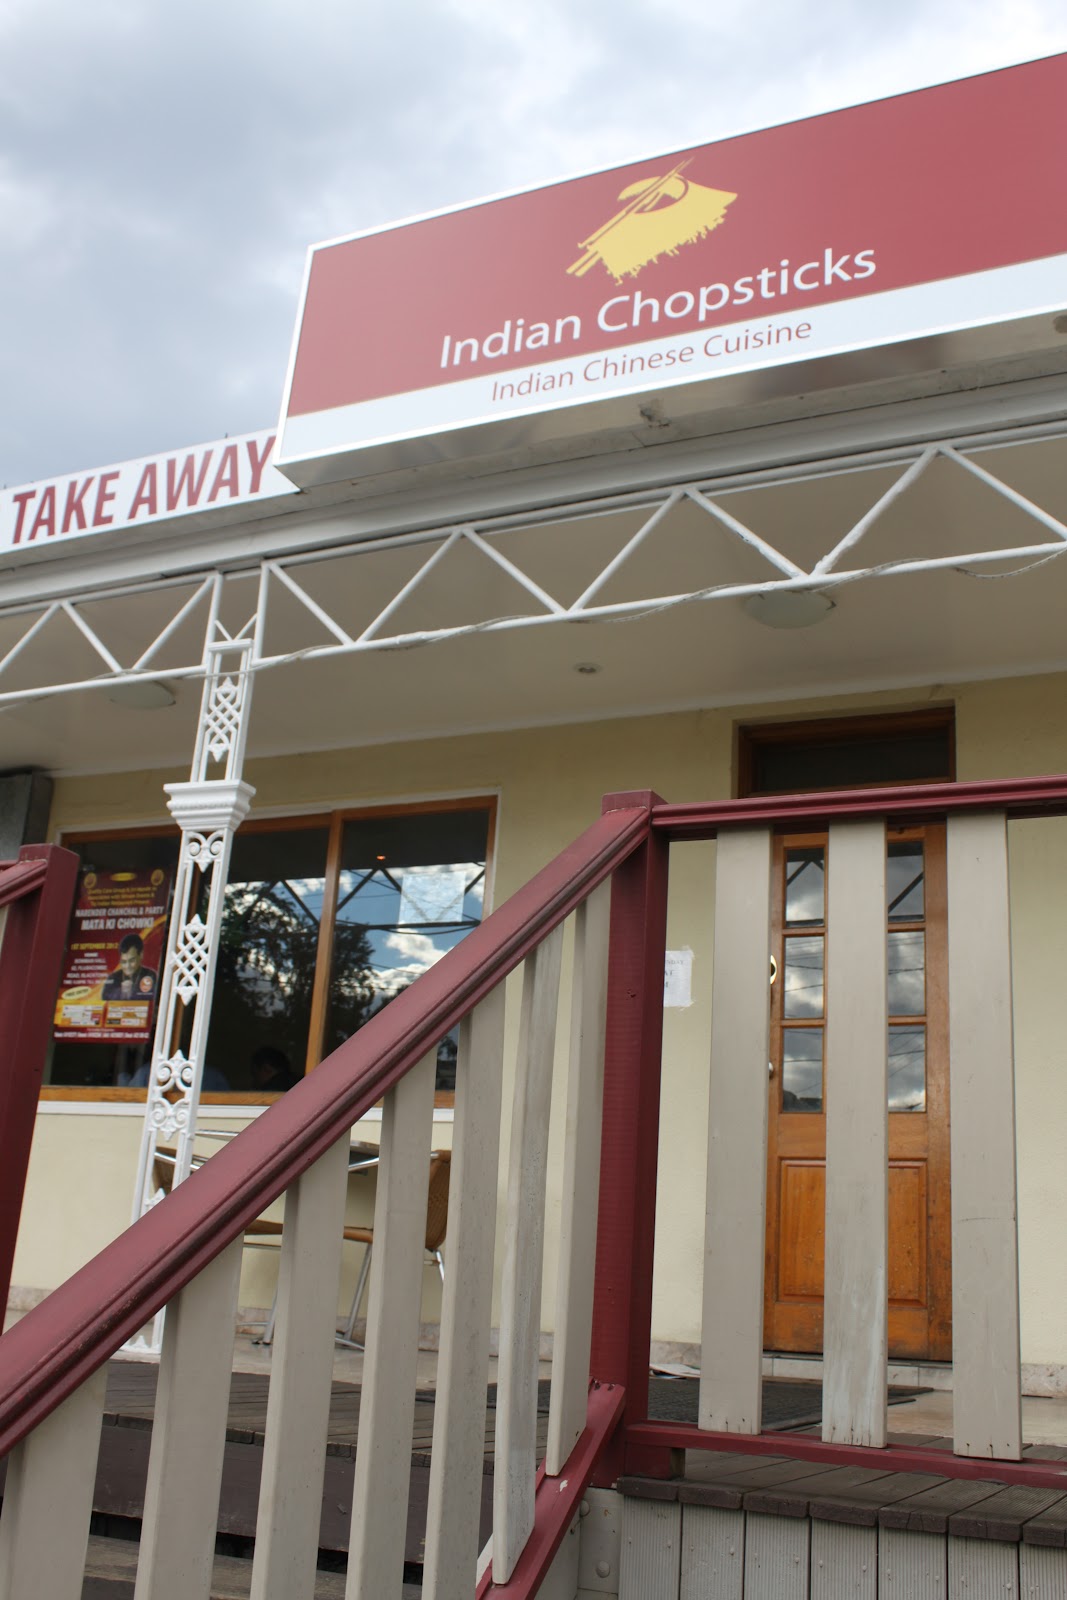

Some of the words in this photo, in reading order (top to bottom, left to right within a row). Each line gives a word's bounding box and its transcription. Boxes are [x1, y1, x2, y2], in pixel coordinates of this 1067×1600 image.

[440, 313, 582, 368] Indian
[597, 247, 878, 332] Chopsticks
[491, 367, 574, 402] Indian
[583, 346, 695, 381] Chinese
[703, 321, 813, 357] Cuisine
[12, 470, 121, 545] TAKE
[127, 435, 277, 521] AWAY
[81, 918, 105, 931] MATA
[117, 917, 154, 930] CHOWKI
[145, 906, 164, 915] PARTY
